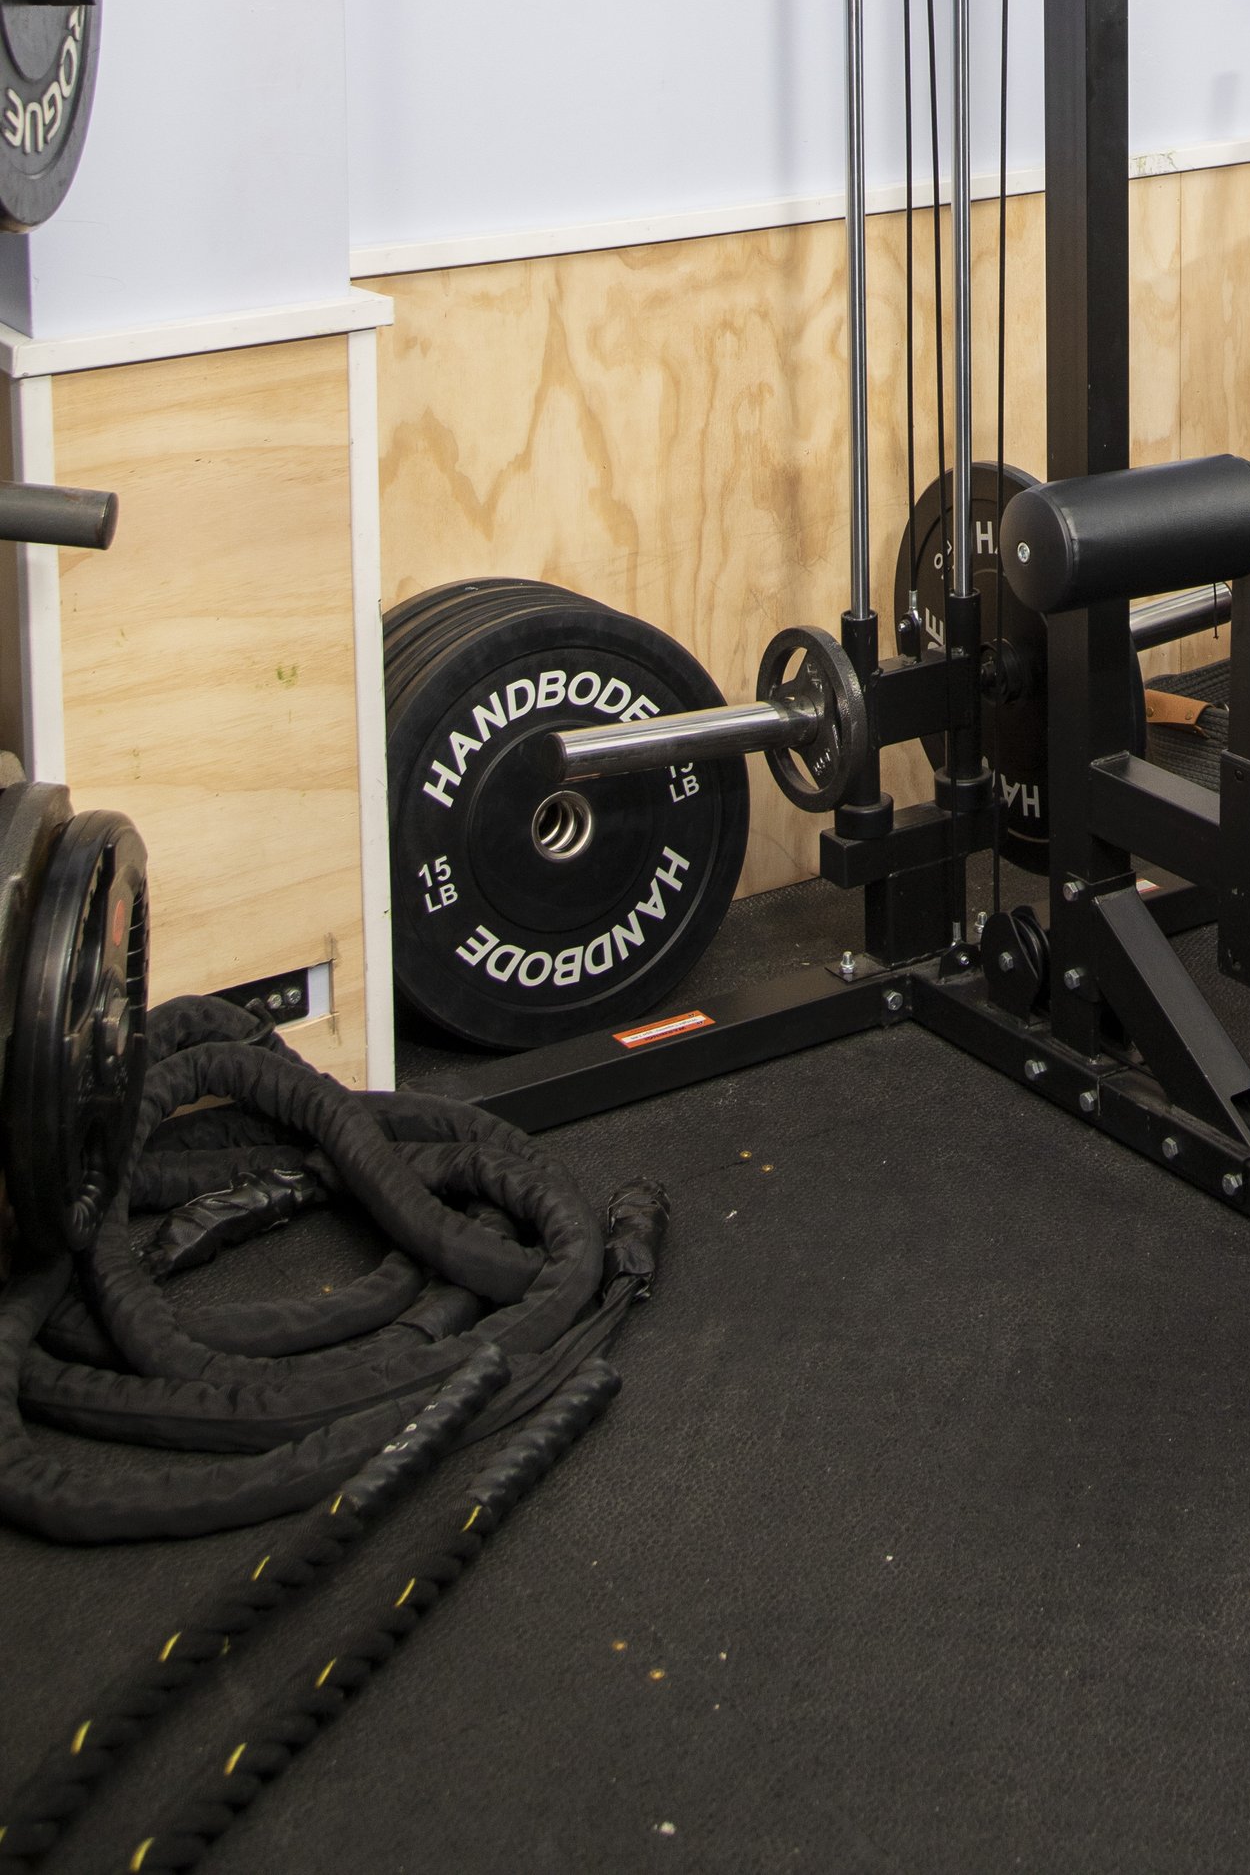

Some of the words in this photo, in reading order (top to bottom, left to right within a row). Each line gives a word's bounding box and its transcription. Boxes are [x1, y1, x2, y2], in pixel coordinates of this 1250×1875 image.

[422, 670, 661, 809] HANDBODE
[669, 774, 701, 804] LB
[418, 855, 452, 887] 15
[424, 882, 459, 913] LB
[455, 845, 691, 987] HANDBODE
